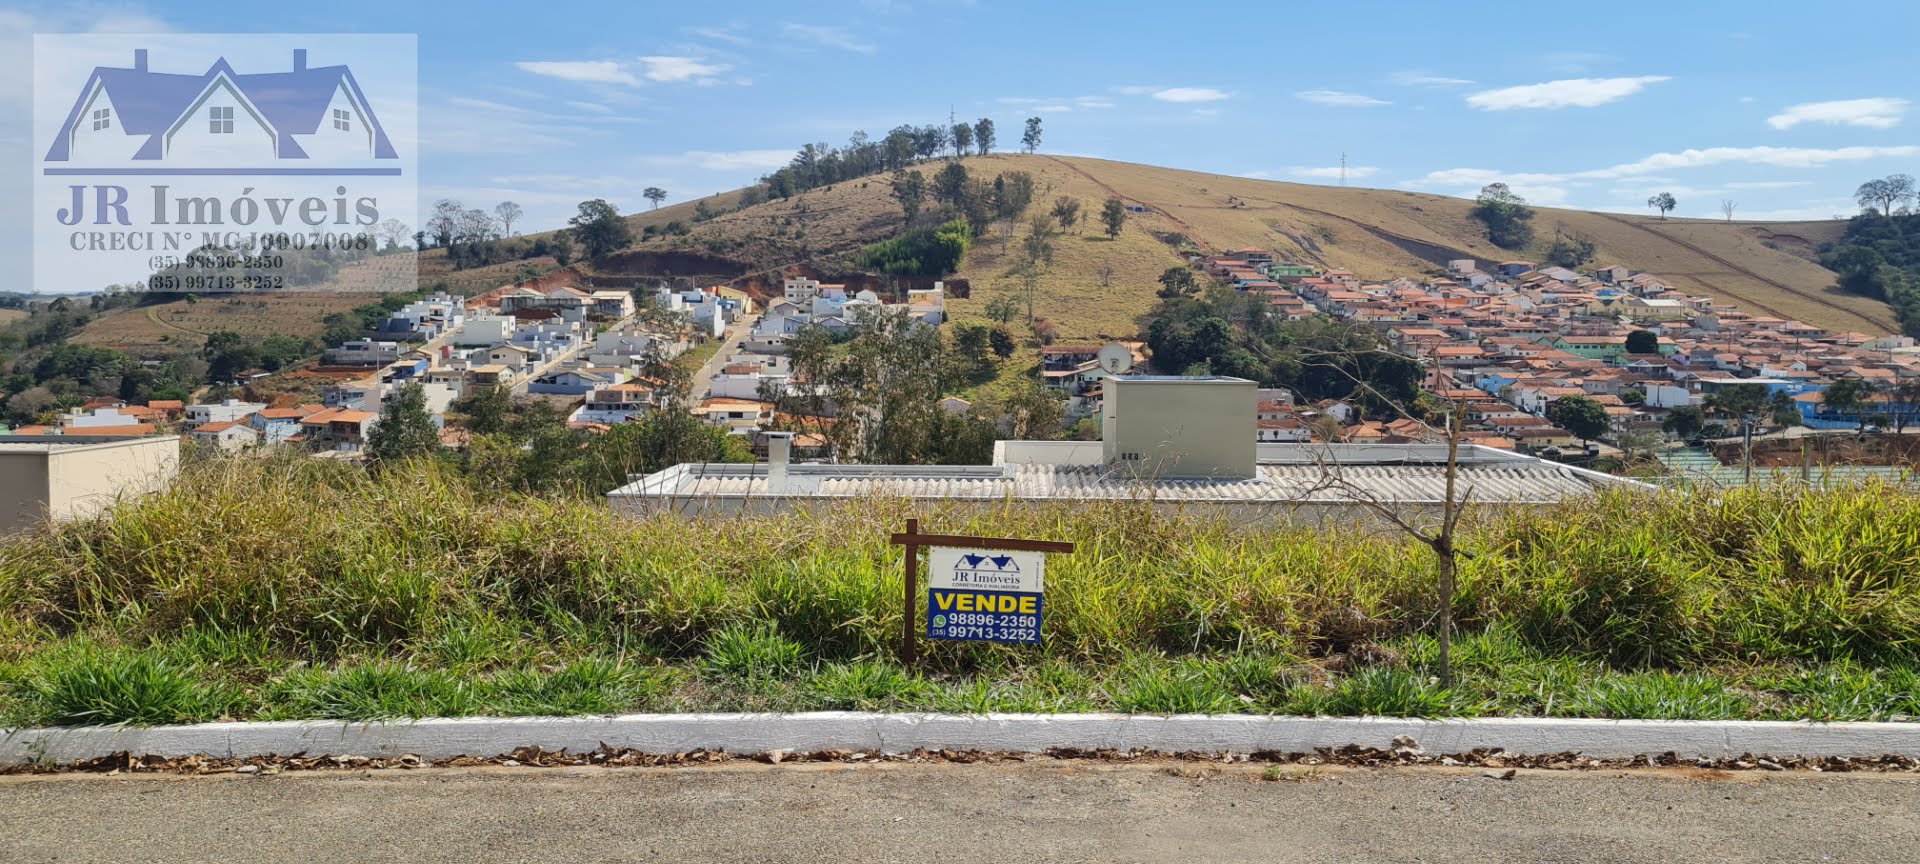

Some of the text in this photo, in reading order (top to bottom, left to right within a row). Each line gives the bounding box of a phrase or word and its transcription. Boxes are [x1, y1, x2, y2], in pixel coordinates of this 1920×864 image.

[952, 571, 968, 582] JR
[973, 572, 1021, 585] Imóveis
[934, 592, 1037, 614] VENDE
[949, 612, 1036, 628] 98896-2350
[932, 626, 1036, 641] (35) 99713-3252
